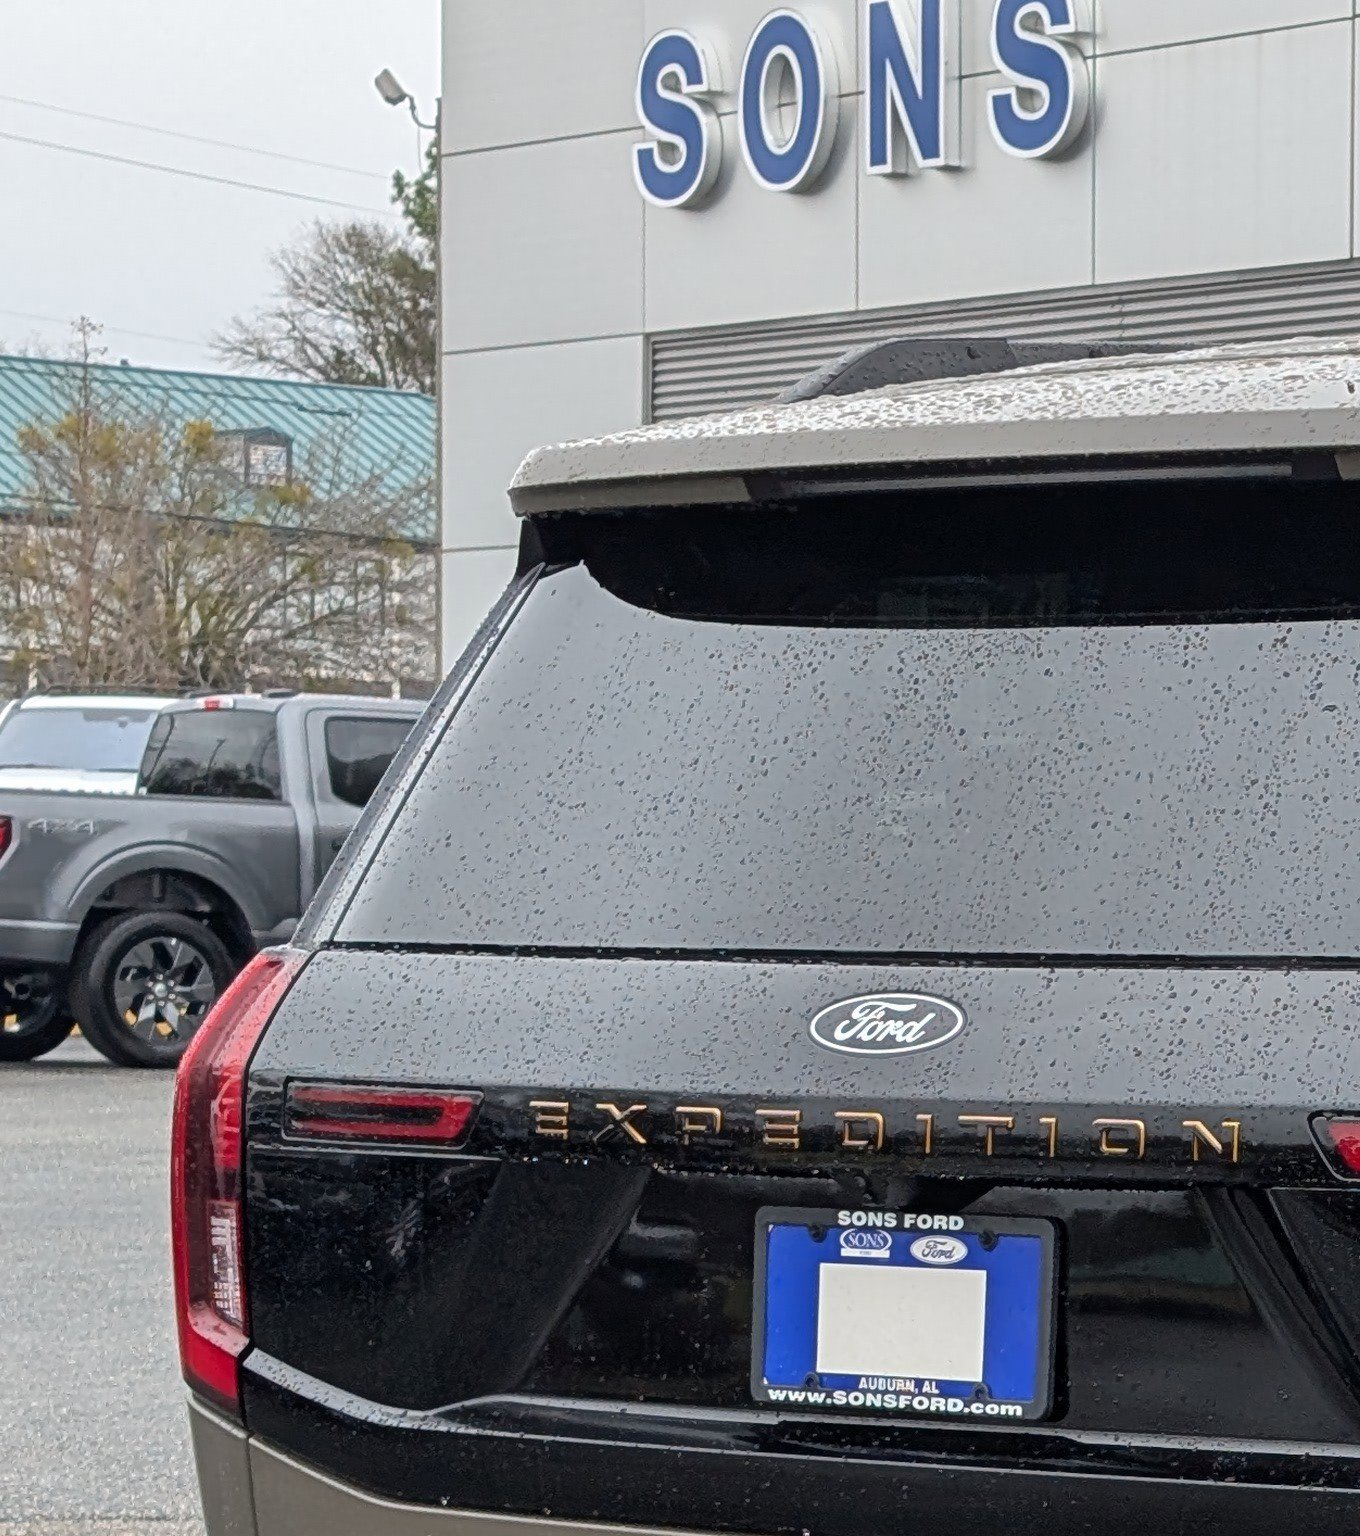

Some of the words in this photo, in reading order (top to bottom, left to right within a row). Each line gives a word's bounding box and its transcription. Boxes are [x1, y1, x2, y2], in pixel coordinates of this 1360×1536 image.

[632, 0, 1078, 207] SONS
[833, 1001, 937, 1045] Ford
[528, 1100, 1243, 1163] EXPEDITION
[837, 1210, 898, 1228] SONS
[903, 1212, 965, 1231] FORD
[847, 1231, 886, 1249] SONS
[921, 1239, 956, 1260] Ford
[858, 1376, 918, 1394] AUBURN,
[921, 1380, 941, 1395] AL
[767, 1388, 1023, 1417] www.SONSFORD.com
